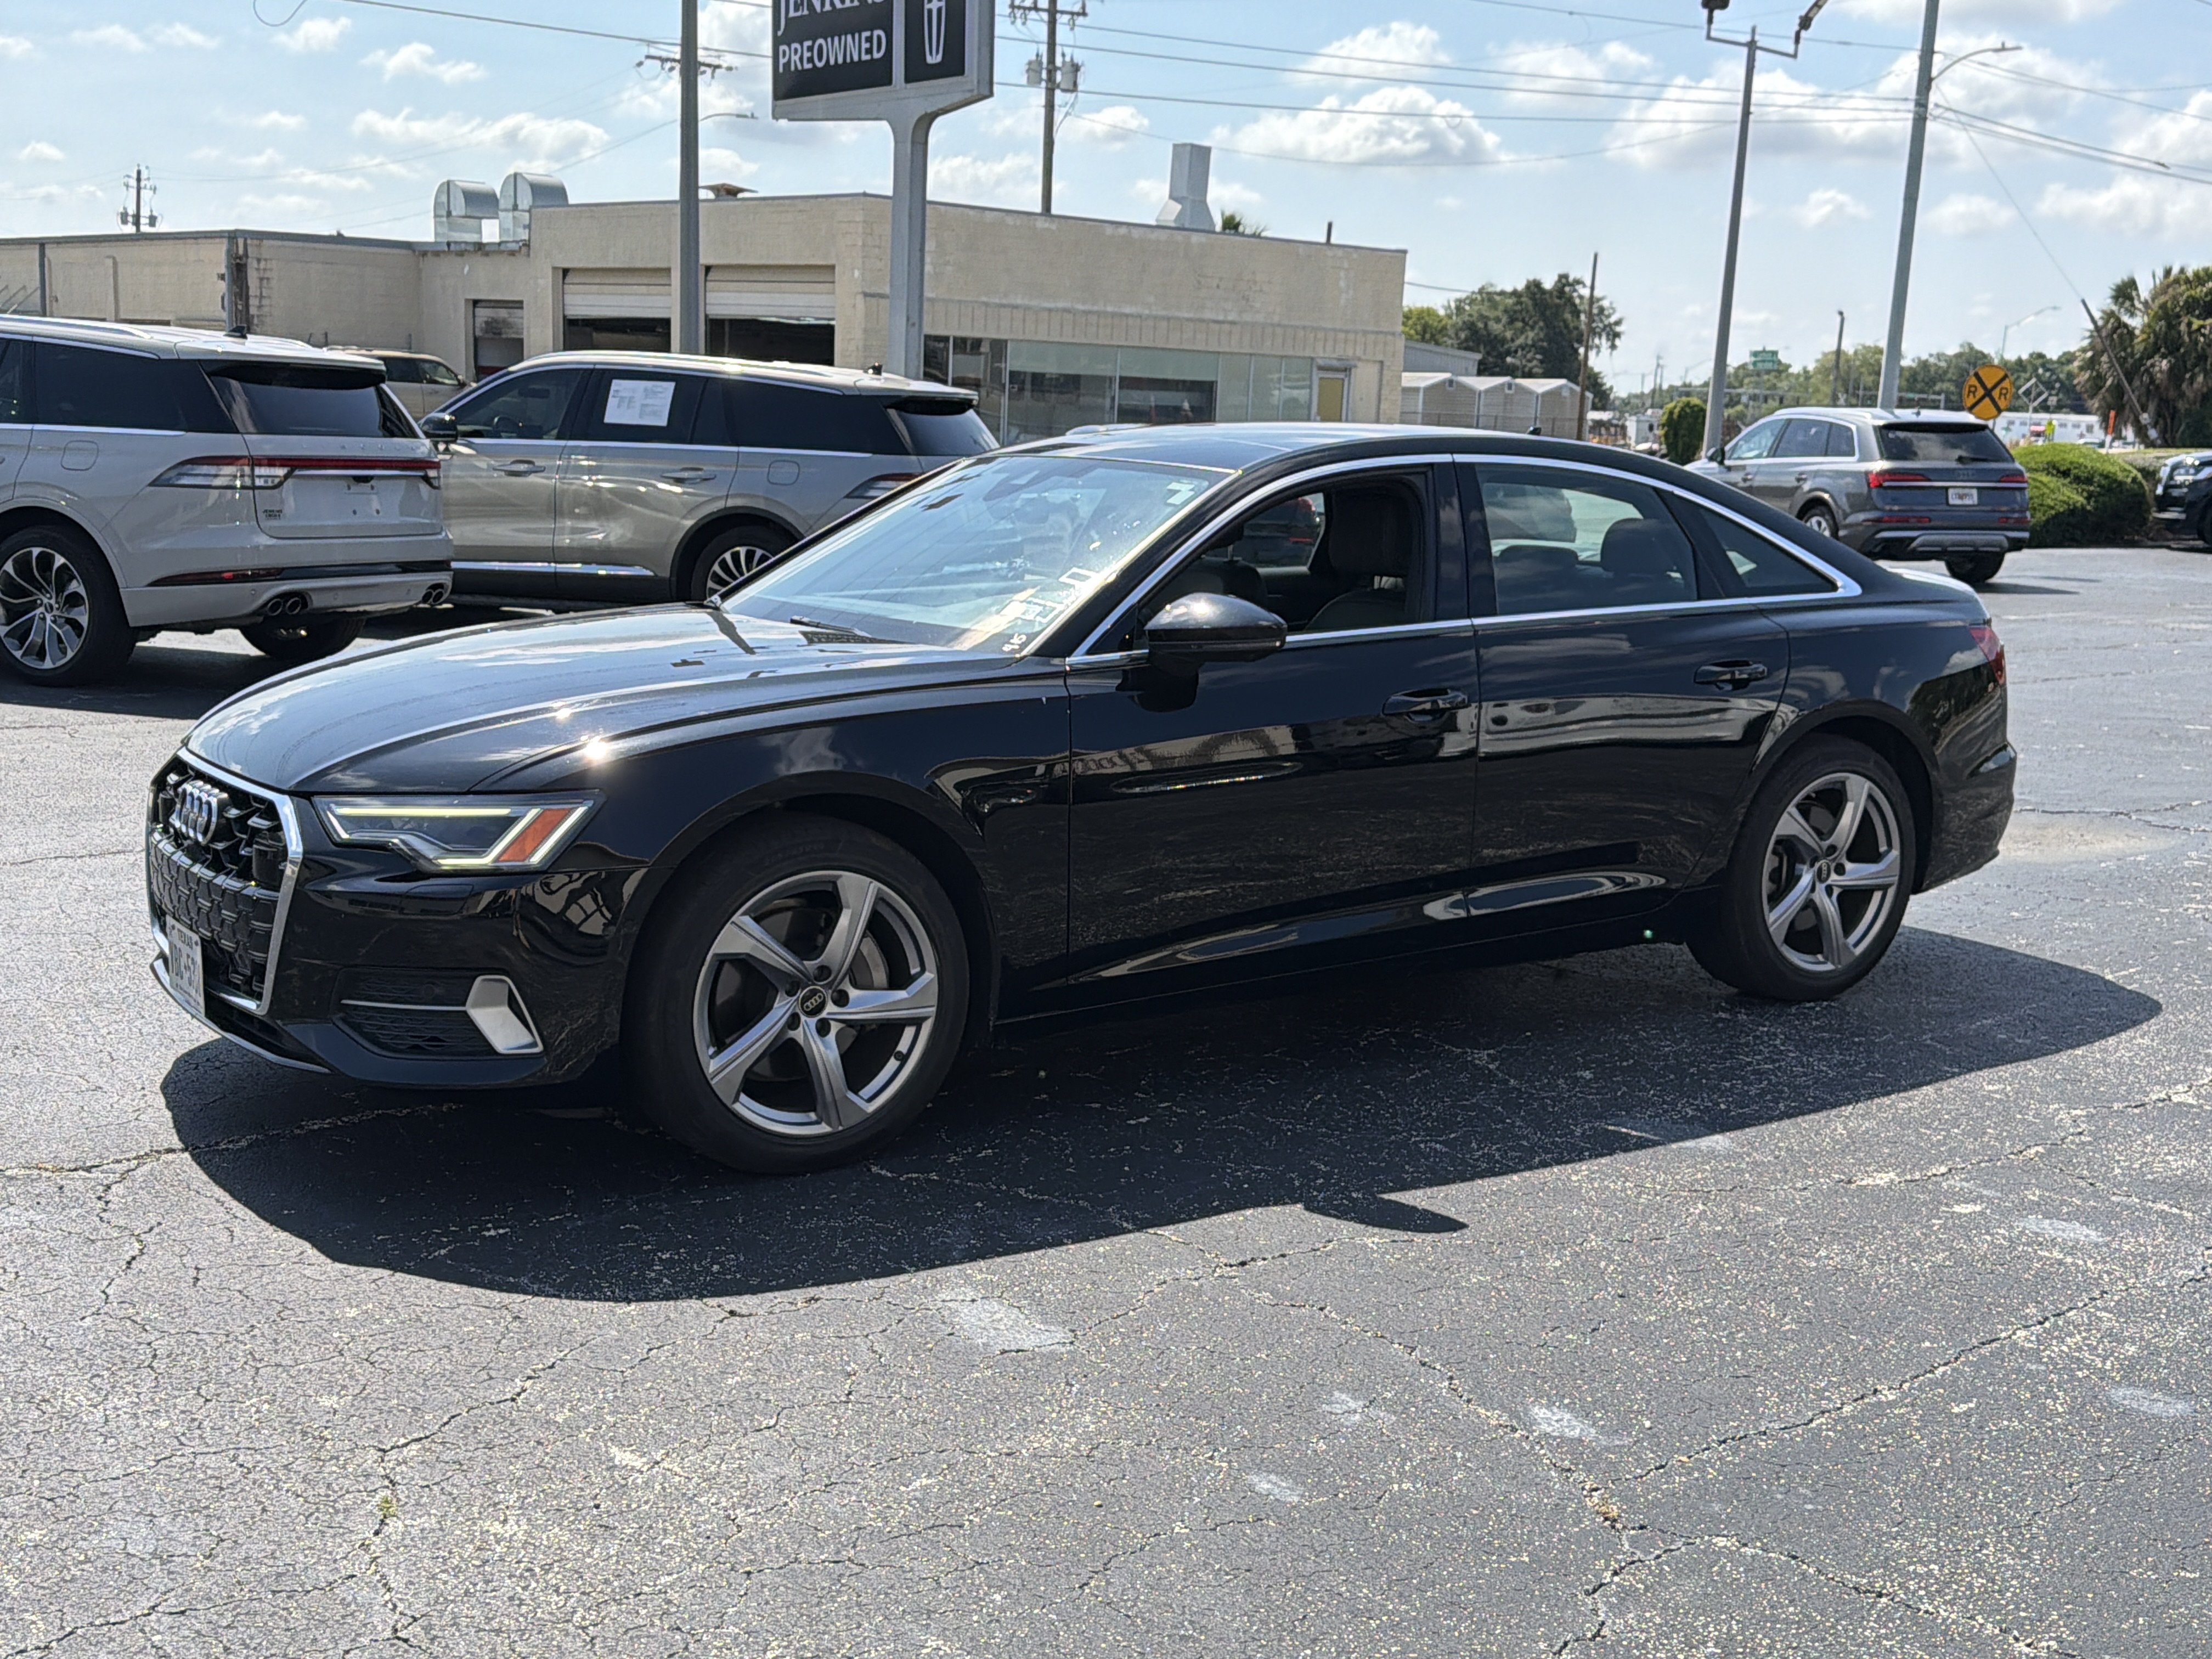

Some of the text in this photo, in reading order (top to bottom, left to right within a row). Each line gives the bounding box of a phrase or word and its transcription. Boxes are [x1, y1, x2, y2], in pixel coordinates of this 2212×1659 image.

[777, 0, 885, 36] JENK
[779, 30, 886, 73] PREOWNED
[1967, 385, 2008, 400] R R
